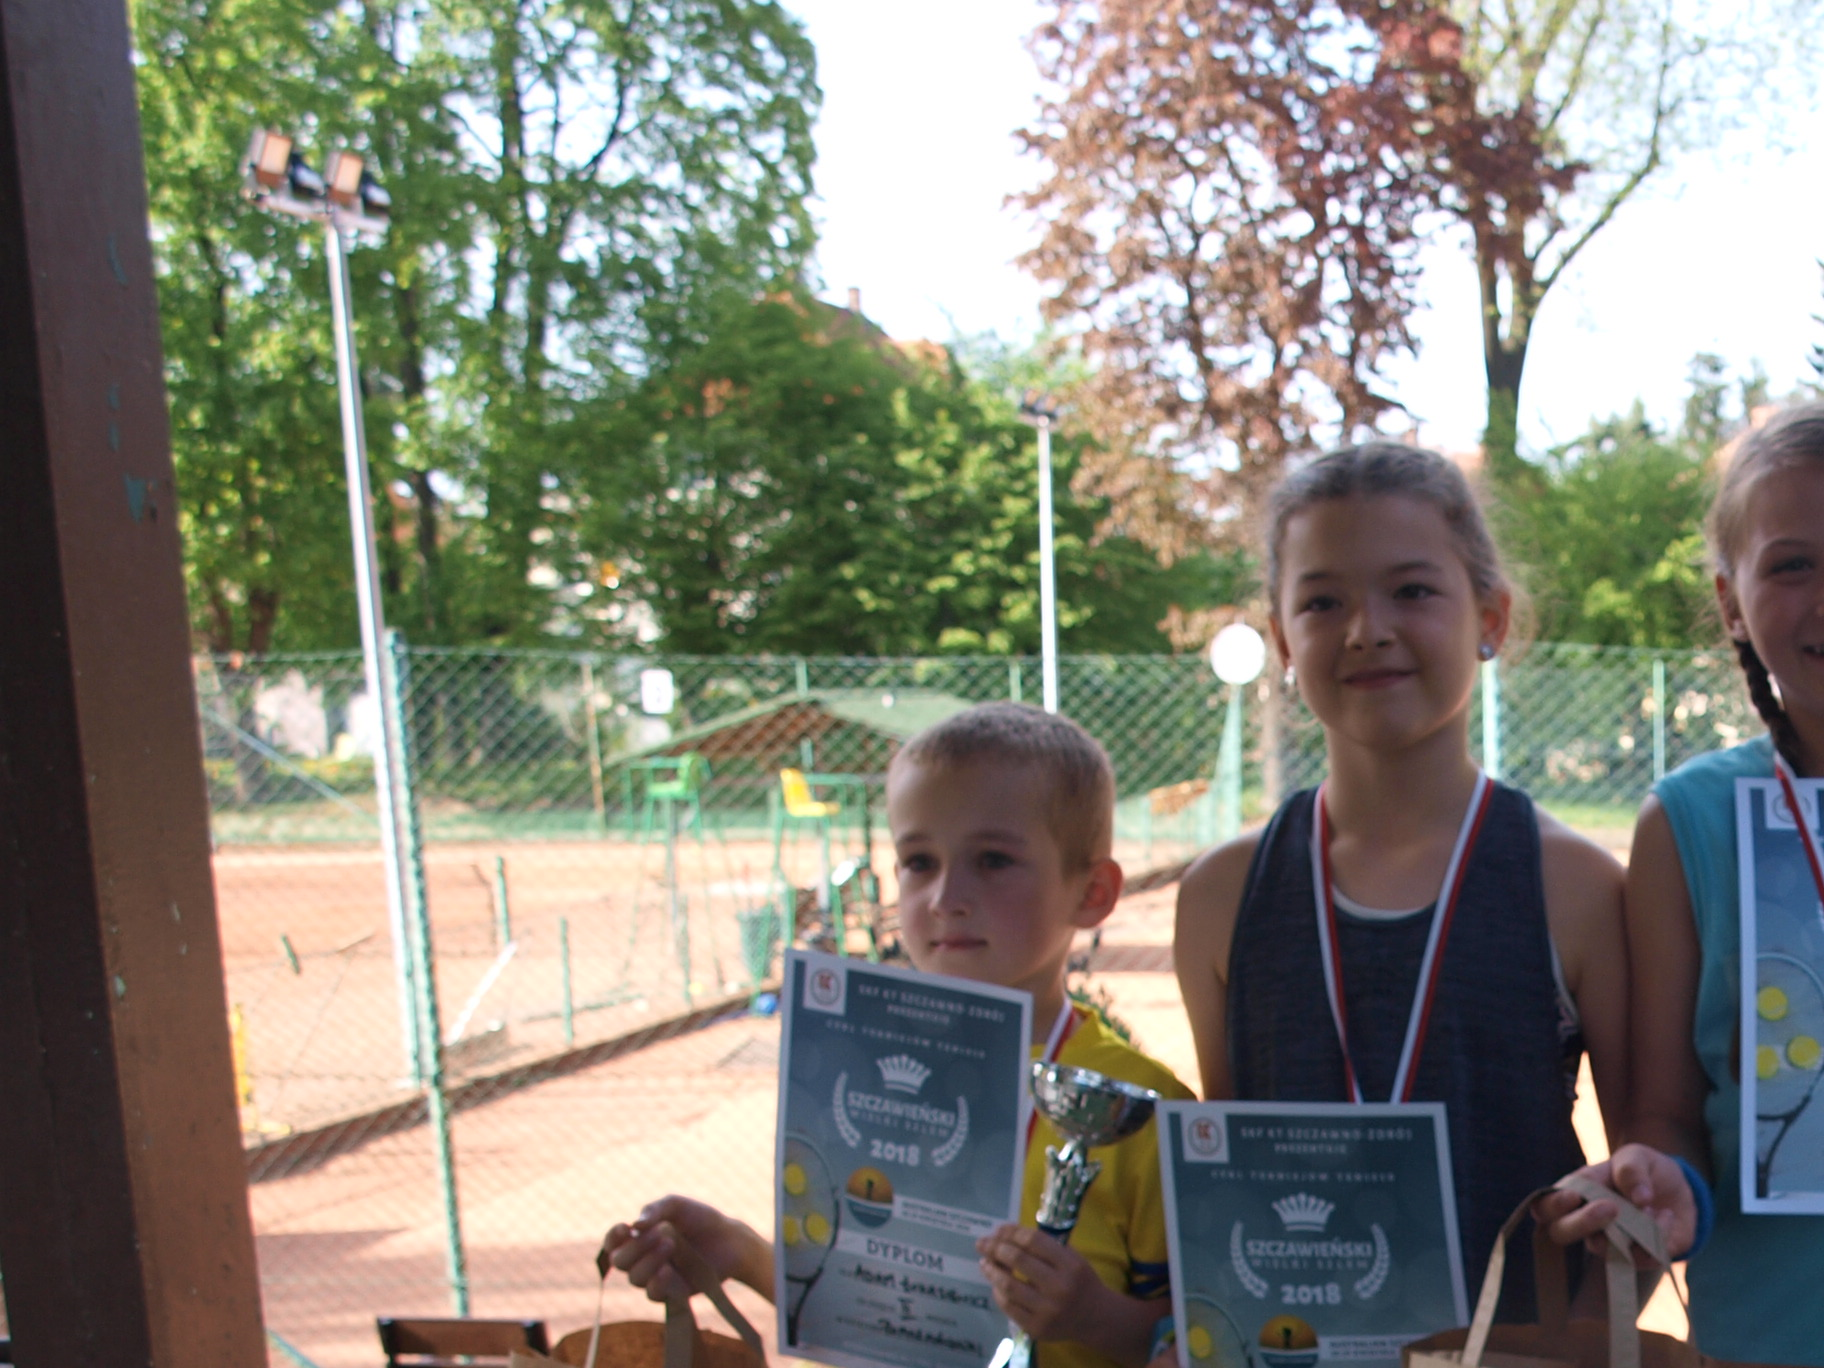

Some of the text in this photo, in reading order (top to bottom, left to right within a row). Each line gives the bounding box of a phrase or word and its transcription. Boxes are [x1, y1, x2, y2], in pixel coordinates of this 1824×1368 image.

[869, 1138, 922, 1168] 2018
[866, 1237, 945, 1273] DYPLOM
[1246, 1236, 1373, 1258] SZCZAWIEŃSKI
[1281, 1282, 1341, 1305] 2018
